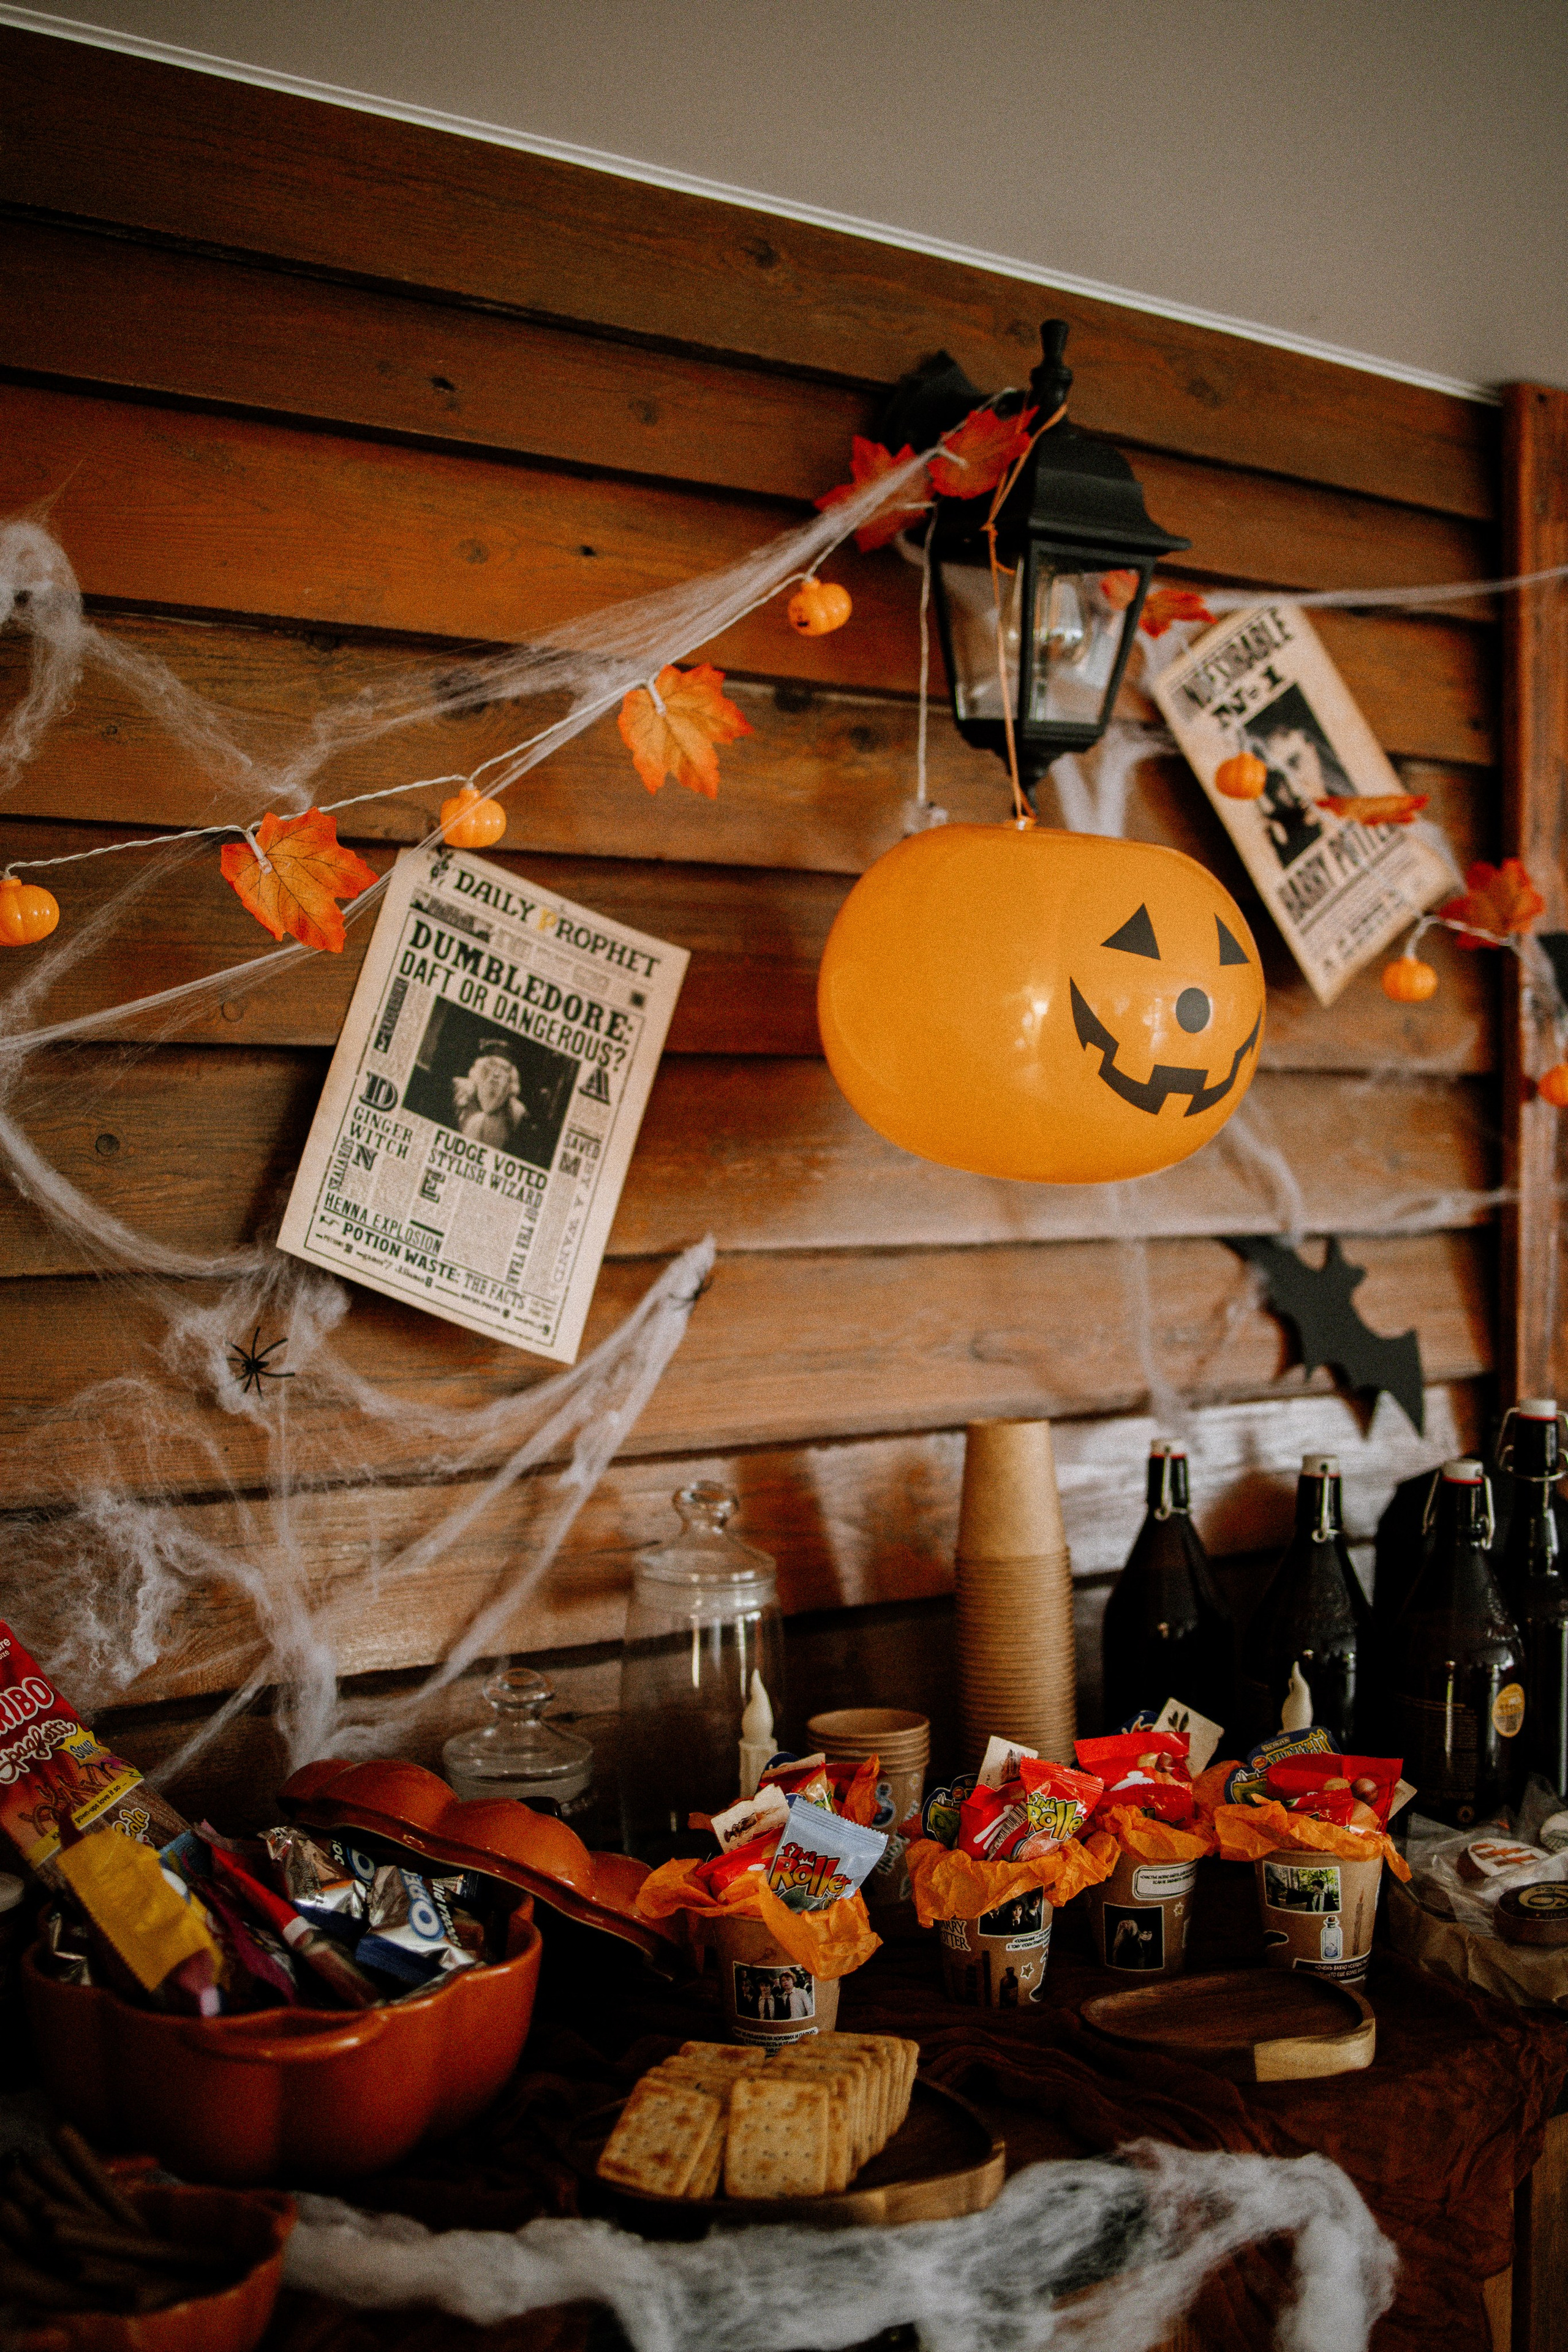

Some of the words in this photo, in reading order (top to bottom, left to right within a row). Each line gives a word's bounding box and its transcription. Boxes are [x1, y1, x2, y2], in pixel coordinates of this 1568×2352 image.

[454, 869, 535, 922] DAILY
[538, 908, 661, 978] PROPHET
[409, 920, 634, 1045] DUMBLEDORE:
[399, 950, 455, 993] DAFT
[459, 980, 489, 1012] OR
[492, 994, 627, 1072] DANGEROUS?
[350, 1122, 409, 1159] WITCH
[353, 1105, 413, 1144] GINGER
[563, 1133, 601, 1160] SAVED
[428, 1147, 488, 1186] STYLISH
[490, 1171, 543, 1210] WIZARD
[434, 1129, 488, 1164] FUDGE
[494, 1154, 549, 1191] VOTED
[325, 1193, 368, 1224] HENNA
[372, 1213, 445, 1254] EXPLOSION
[342, 1222, 401, 1257] POTION
[404, 1249, 461, 1284] WASTE:
[464, 1273, 489, 1295] THE
[489, 1282, 526, 1310] FACTS
[0, 1678, 53, 1733] RIBO
[74, 1801, 100, 1824] grown-ups
[97, 1792, 111, 1807] love
[115, 1784, 122, 1793] so
[1024, 1800, 1084, 1840] Rolle
[939, 1930, 969, 1950] OTTER
[940, 1920, 965, 1935] ARRY
